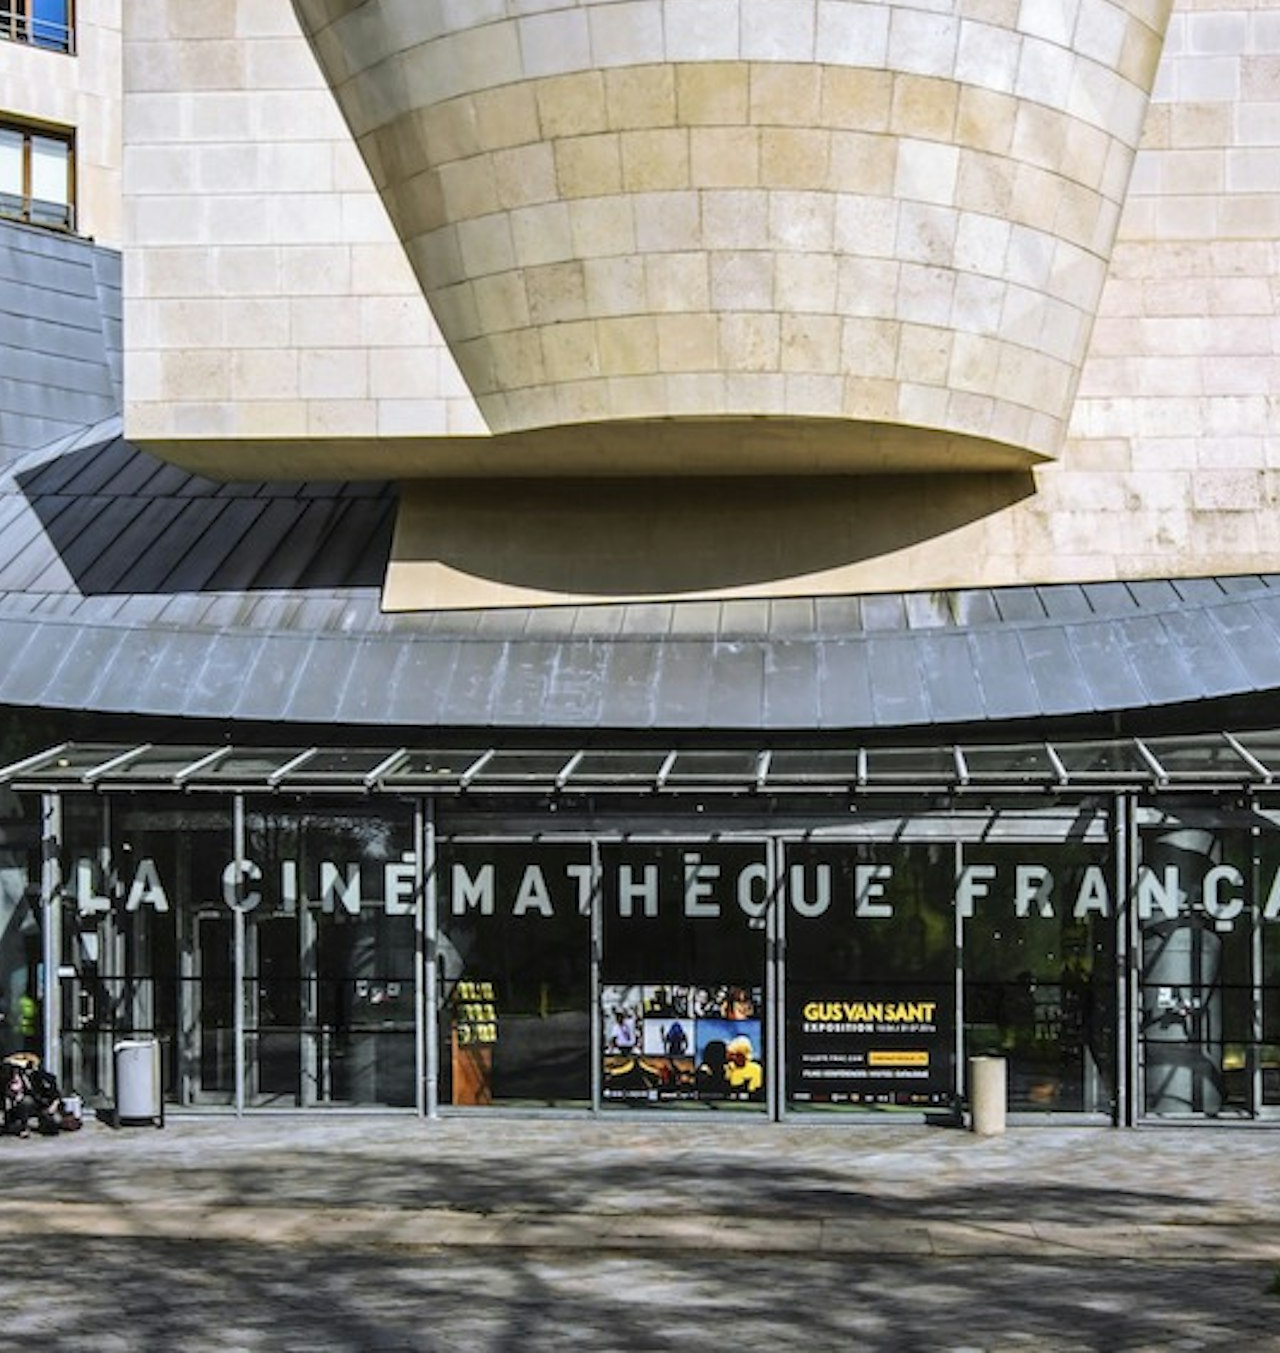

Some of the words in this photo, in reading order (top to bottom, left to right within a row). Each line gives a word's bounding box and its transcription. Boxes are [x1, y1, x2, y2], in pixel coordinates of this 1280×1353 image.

[76, 857, 169, 915] LA
[803, 1002, 843, 1022] GUS
[842, 1002, 883, 1022] VAN
[884, 1002, 937, 1023] SANT
[803, 1022, 874, 1033] EXPOSITION
